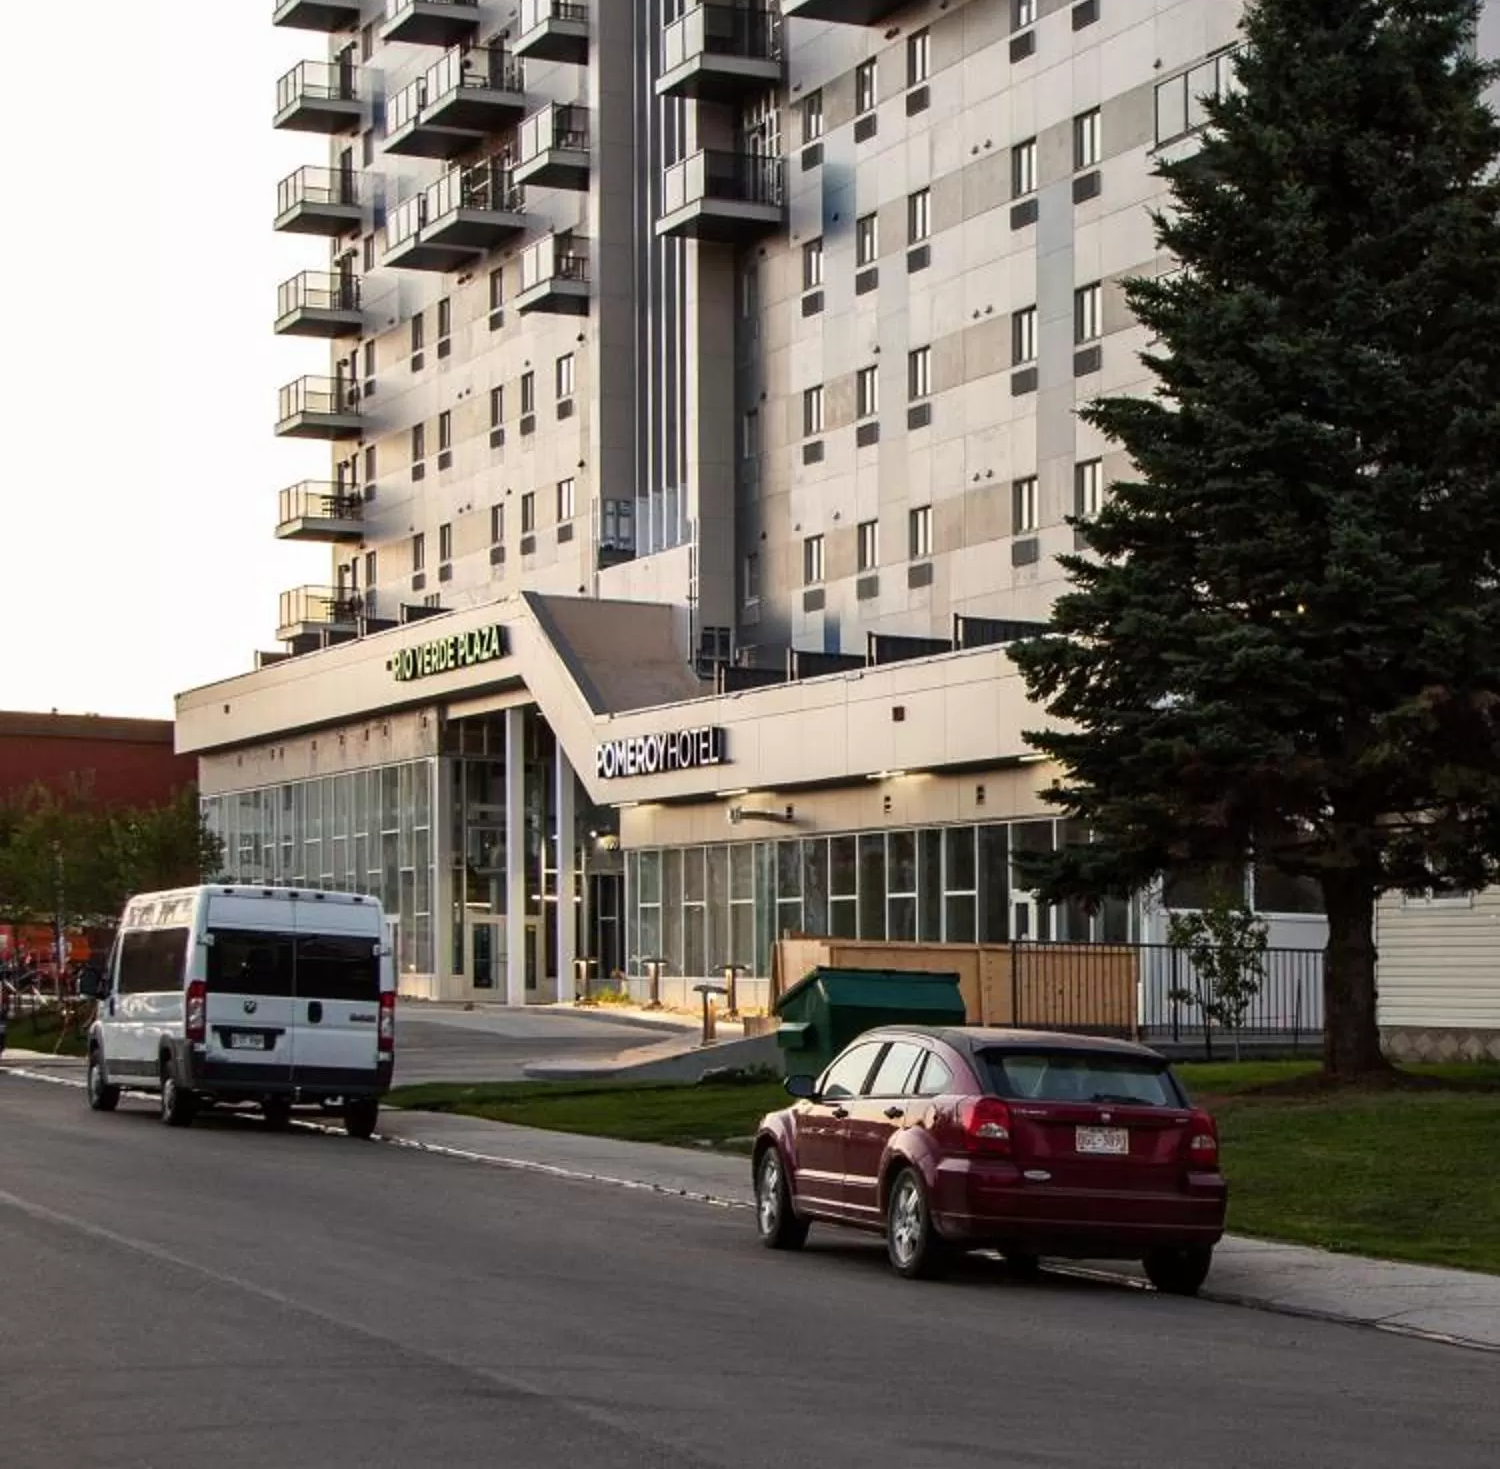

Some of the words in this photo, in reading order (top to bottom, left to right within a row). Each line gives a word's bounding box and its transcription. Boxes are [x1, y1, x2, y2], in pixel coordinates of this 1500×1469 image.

[415, 636, 455, 678] VERDE
[458, 623, 501, 666] PLAZA
[596, 732, 667, 778] POMEROY
[667, 725, 720, 768] HOTEL
